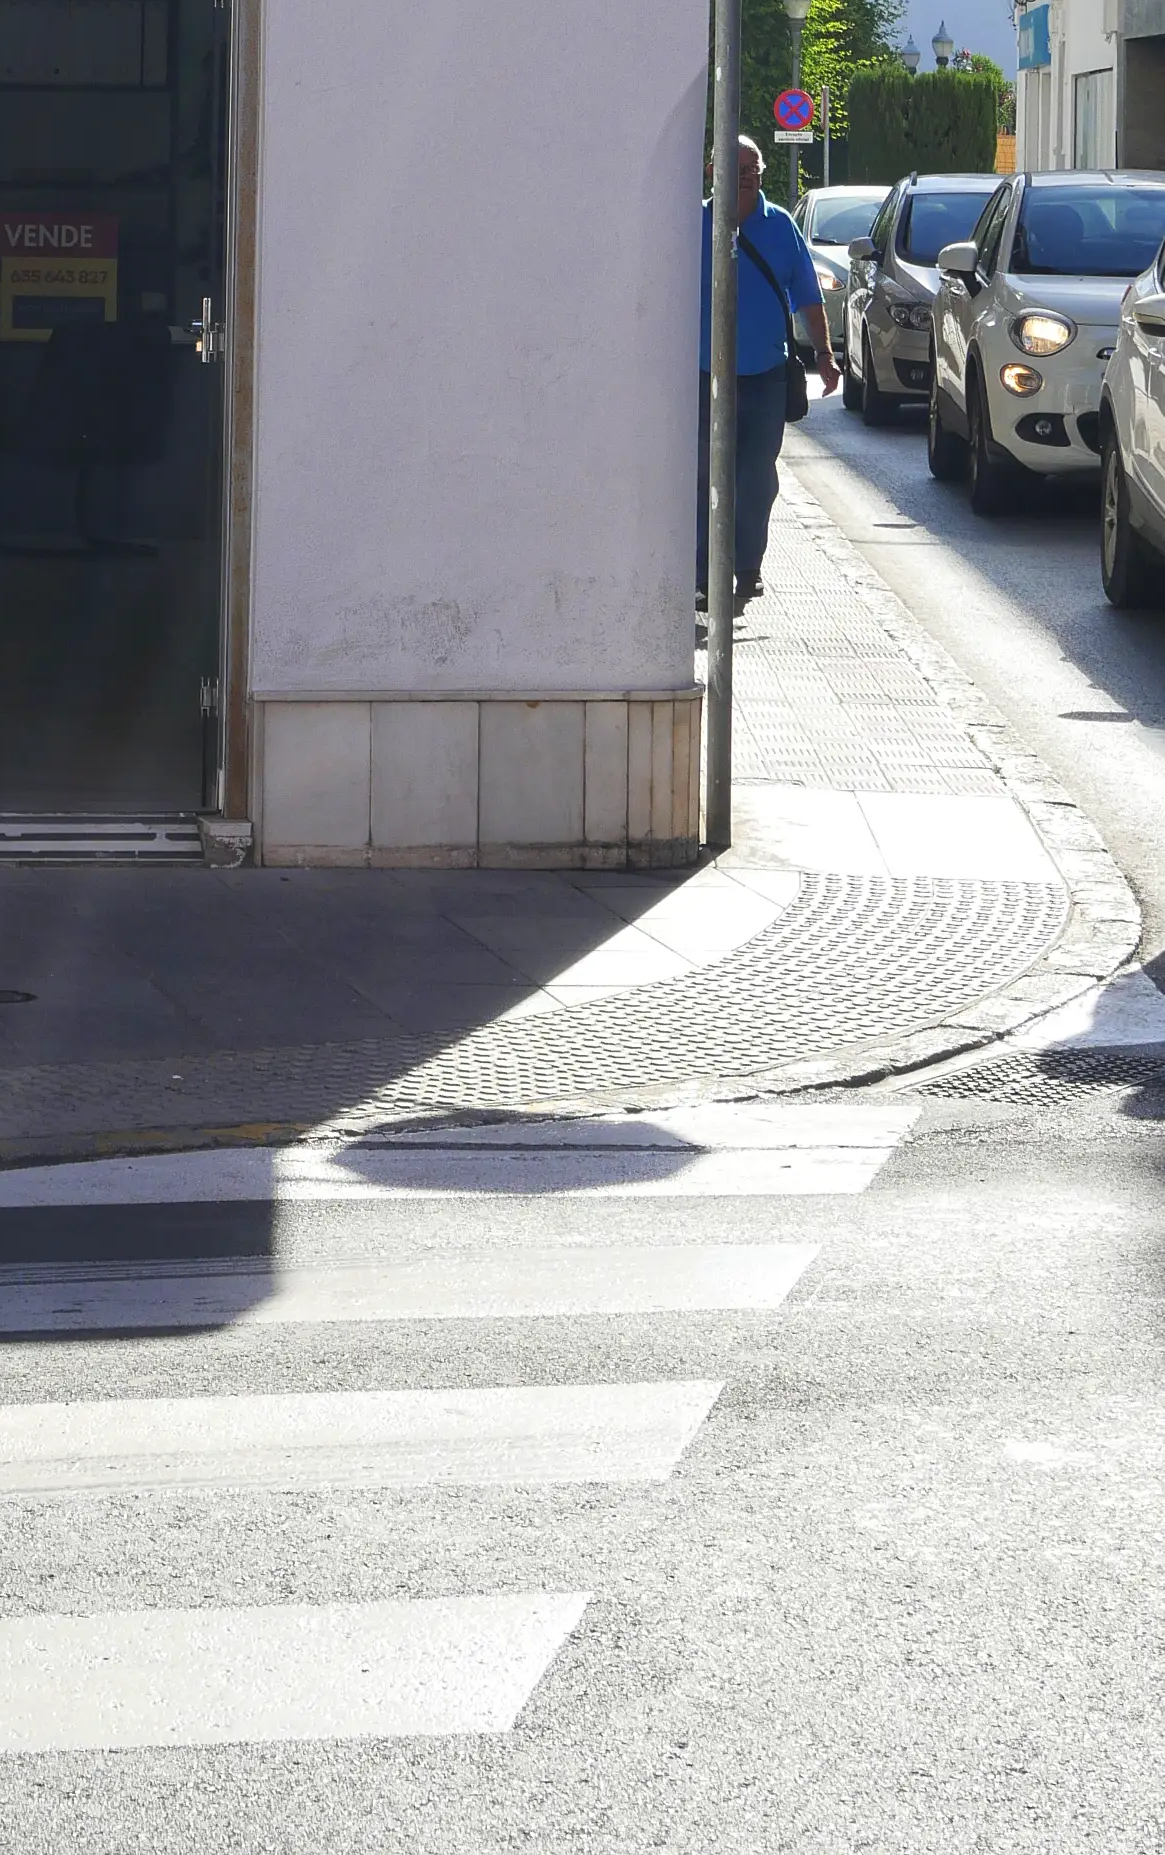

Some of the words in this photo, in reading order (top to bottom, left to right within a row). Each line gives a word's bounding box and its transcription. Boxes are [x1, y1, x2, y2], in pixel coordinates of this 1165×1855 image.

[4, 223, 94, 248] VENDE
[10, 269, 41, 284] 635
[44, 269, 75, 284] 643
[78, 269, 109, 284] 827
